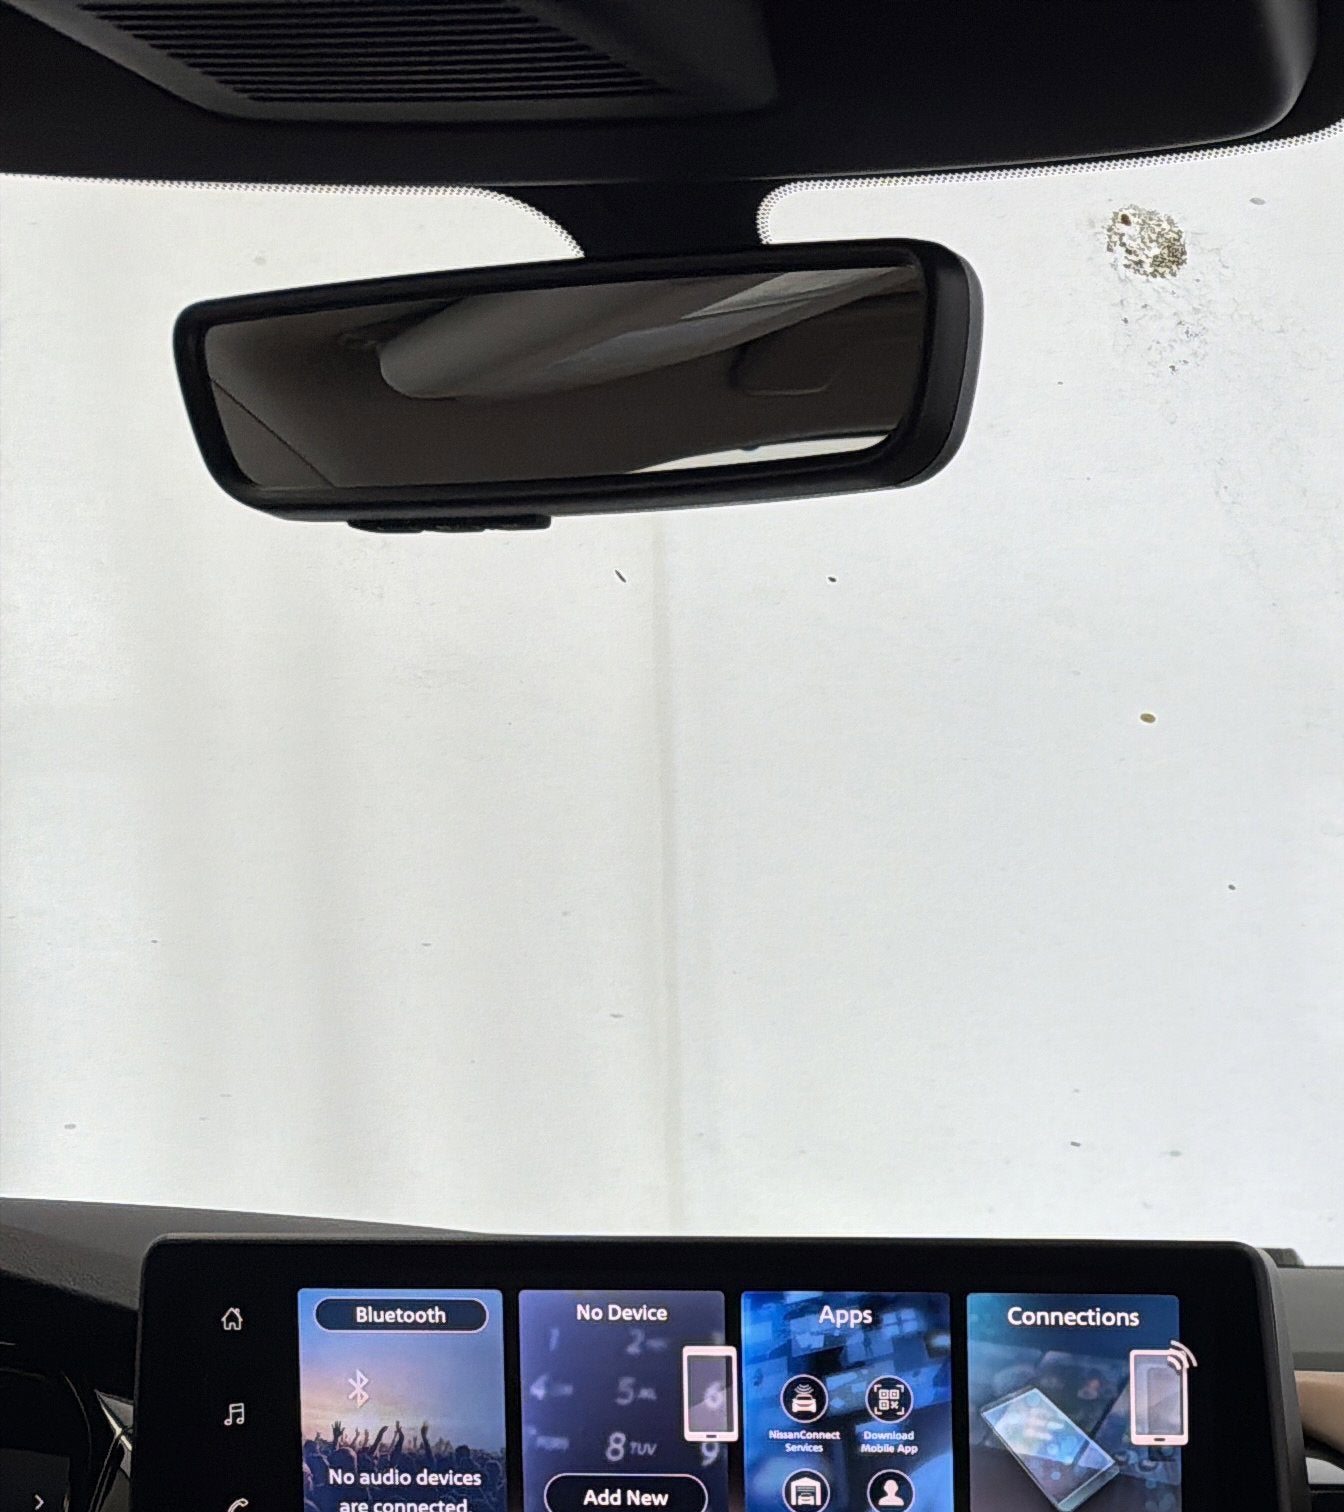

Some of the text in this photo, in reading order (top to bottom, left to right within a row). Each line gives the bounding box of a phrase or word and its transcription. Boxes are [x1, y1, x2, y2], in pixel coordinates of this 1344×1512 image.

[355, 1306, 446, 1324] Bluetooth
[576, 1304, 668, 1321] No Device
[819, 1305, 872, 1328] Apps
[1007, 1307, 1139, 1327] Connections
[768, 1429, 840, 1441] NissanConnect
[863, 1430, 915, 1441] Download
[606, 1432, 626, 1461] 8
[785, 1442, 823, 1454] Services
[860, 1443, 919, 1456] Mobile App
[328, 1468, 482, 1486] No audio devices
[583, 1490, 668, 1507] Add New
